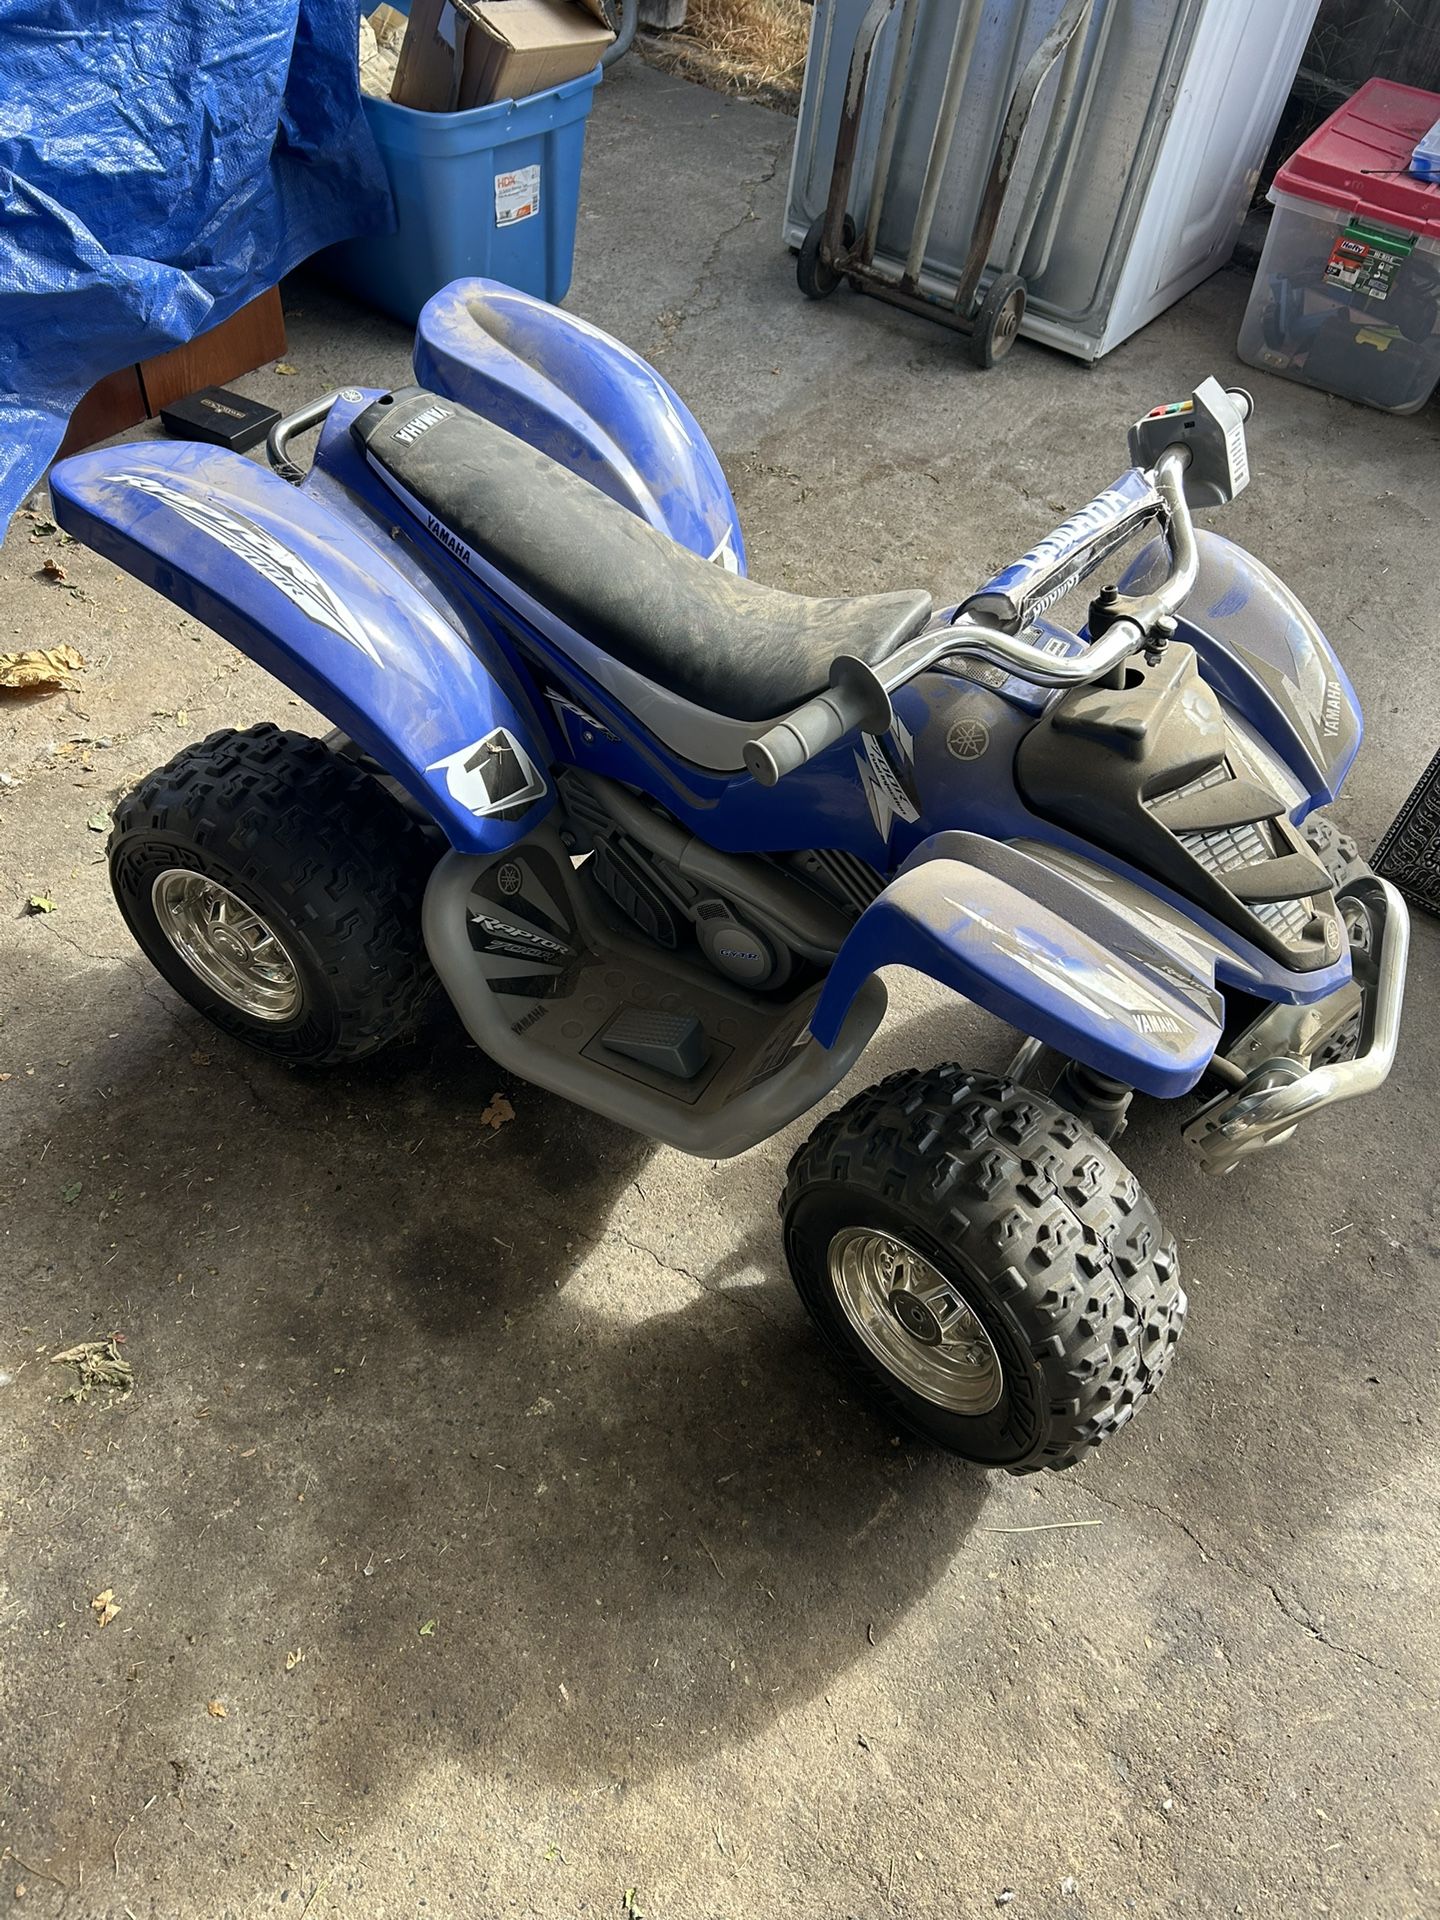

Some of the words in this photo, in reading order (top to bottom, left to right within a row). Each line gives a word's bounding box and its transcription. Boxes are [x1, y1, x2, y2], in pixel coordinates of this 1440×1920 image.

[497, 176, 516, 189] HDX
[1341, 241, 1365, 254] Hefty
[394, 406, 453, 442] YAMAHA
[428, 515, 470, 564] YAMAHA
[230, 542, 304, 597] 700R
[1324, 681, 1341, 736] YAMAHA
[471, 913, 568, 954] RAPTOR
[720, 948, 761, 960] GYTR
[510, 1005, 549, 1036] YAMAHA
[1132, 1015, 1183, 1033] YAMAHA
